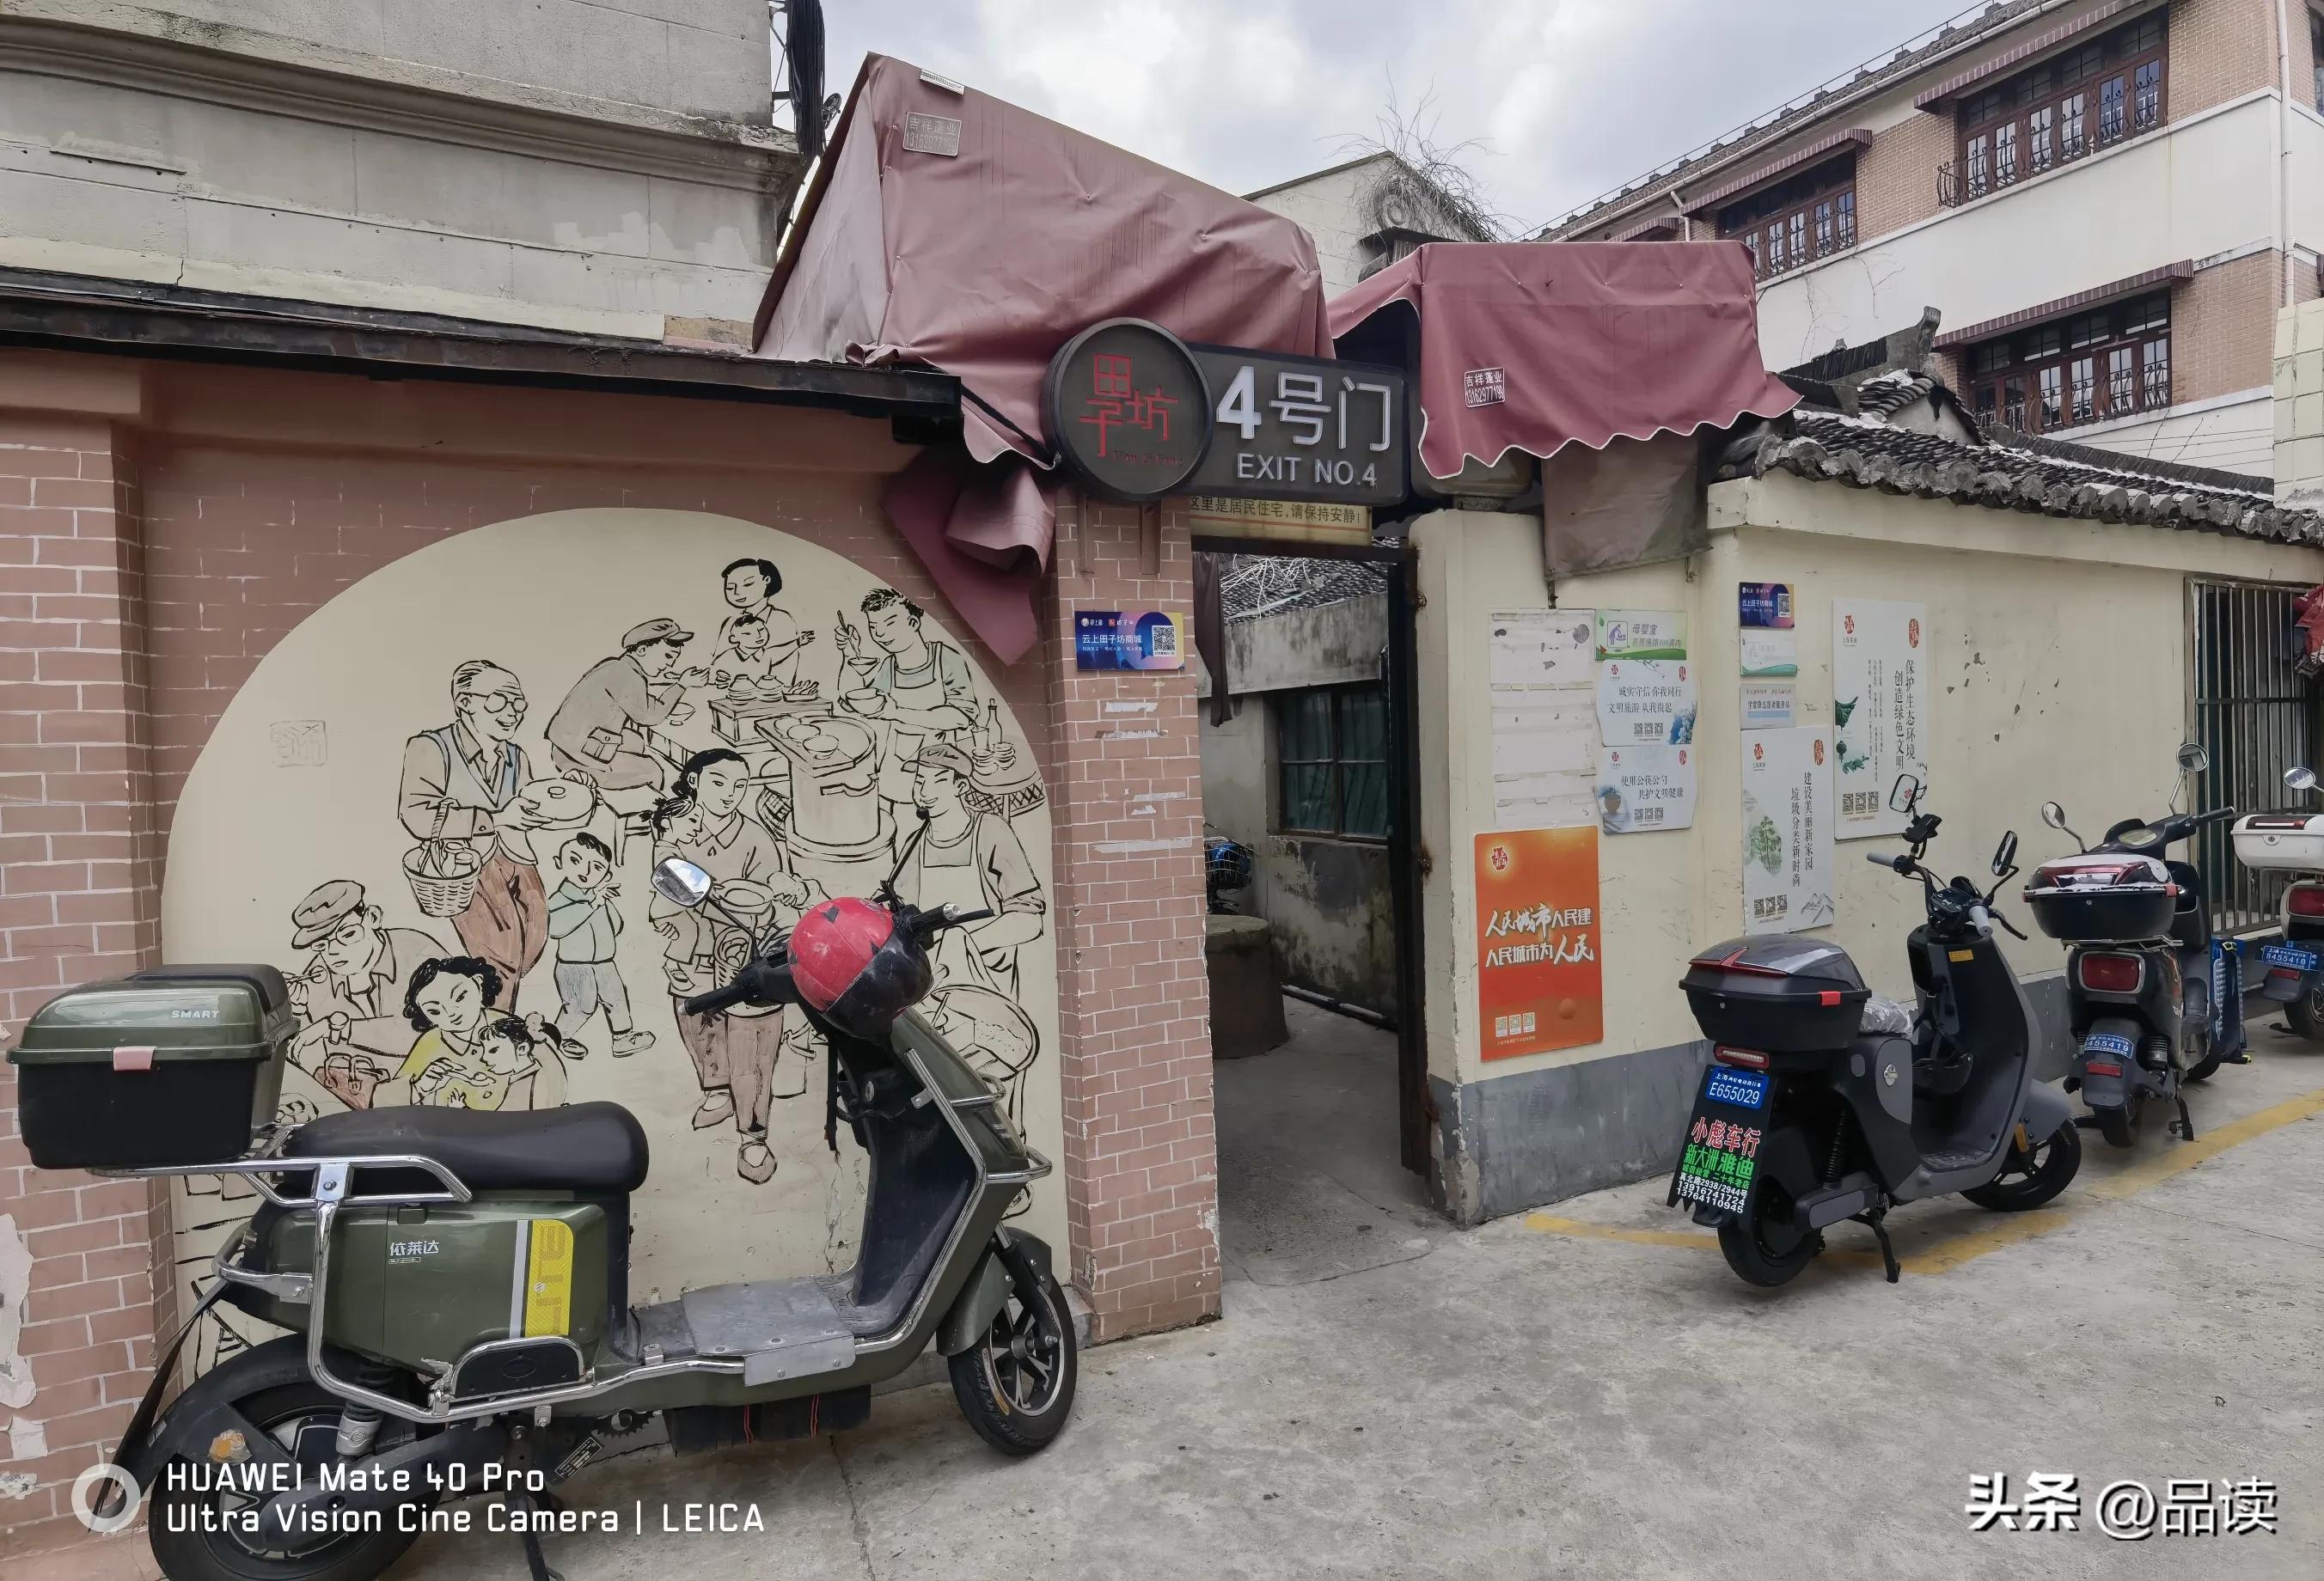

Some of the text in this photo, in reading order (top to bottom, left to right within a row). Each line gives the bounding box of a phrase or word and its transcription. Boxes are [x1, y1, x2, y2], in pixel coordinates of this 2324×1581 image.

[1216, 365, 1391, 452] 4号门
[1237, 453, 1377, 486] EXIT NO.4
[1082, 634, 1142, 644] 云上田子坊商城
[1893, 669, 1905, 771] 创造绿色文明
[1905, 659, 1916, 760] 保护生态环境
[1790, 787, 1801, 888] 垃圾分类新时尚
[1803, 771, 1813, 870] 建设美丽新家园
[1485, 901, 1592, 938] 人民城市人民建
[1485, 933, 1594, 968] 人民城市为人民
[1709, 1082, 1759, 1104] E655029
[1691, 1116, 1761, 1157] 小彪车行
[1678, 1181, 1745, 1206] 13916741724
[1679, 1171, 1748, 1199] 真北路2938/2944号
[1713, 1172, 1750, 1190] 二十年老店
[1677, 1187, 1744, 1214] 13764110945
[389, 1240, 440, 1256] 依莱达
